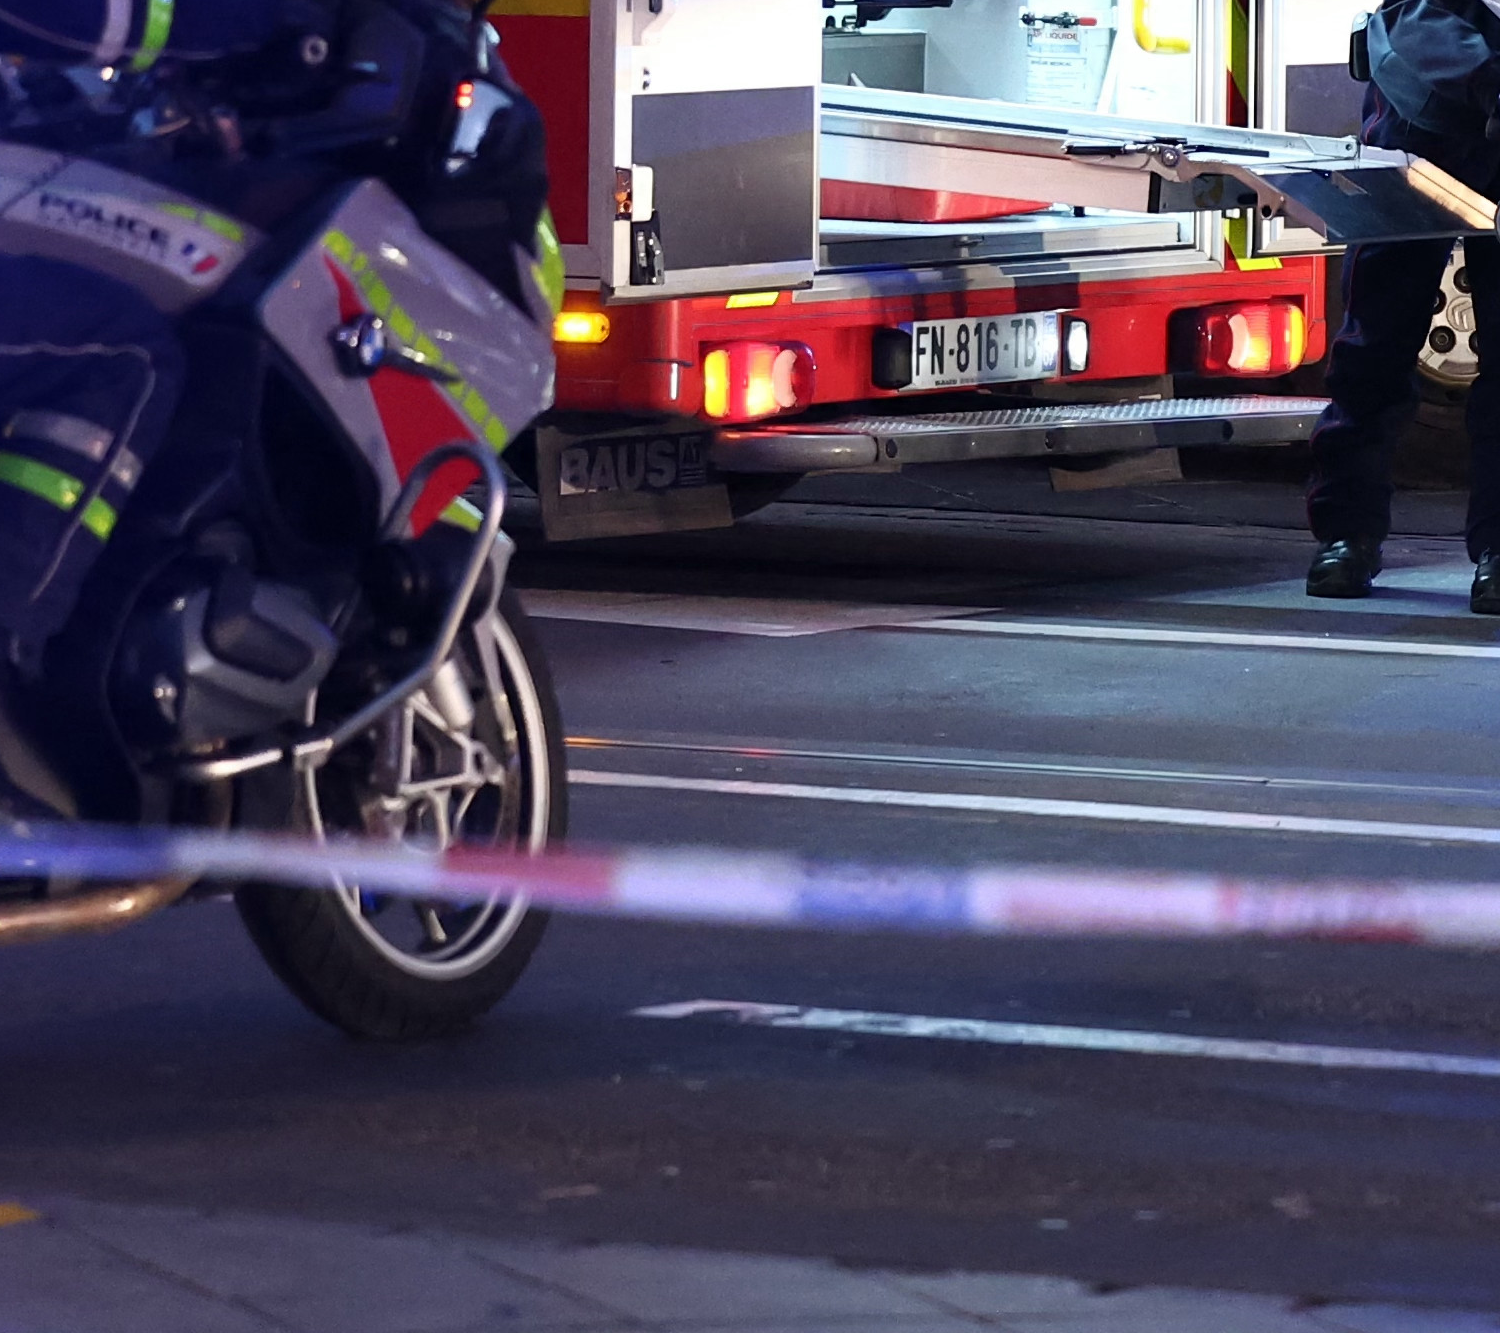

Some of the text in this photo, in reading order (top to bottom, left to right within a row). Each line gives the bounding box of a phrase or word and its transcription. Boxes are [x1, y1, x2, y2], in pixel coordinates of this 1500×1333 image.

[40, 193, 170, 247] POLICE
[916, 318, 1038, 376] FN-816-TB
[560, 437, 678, 496] BAUS
